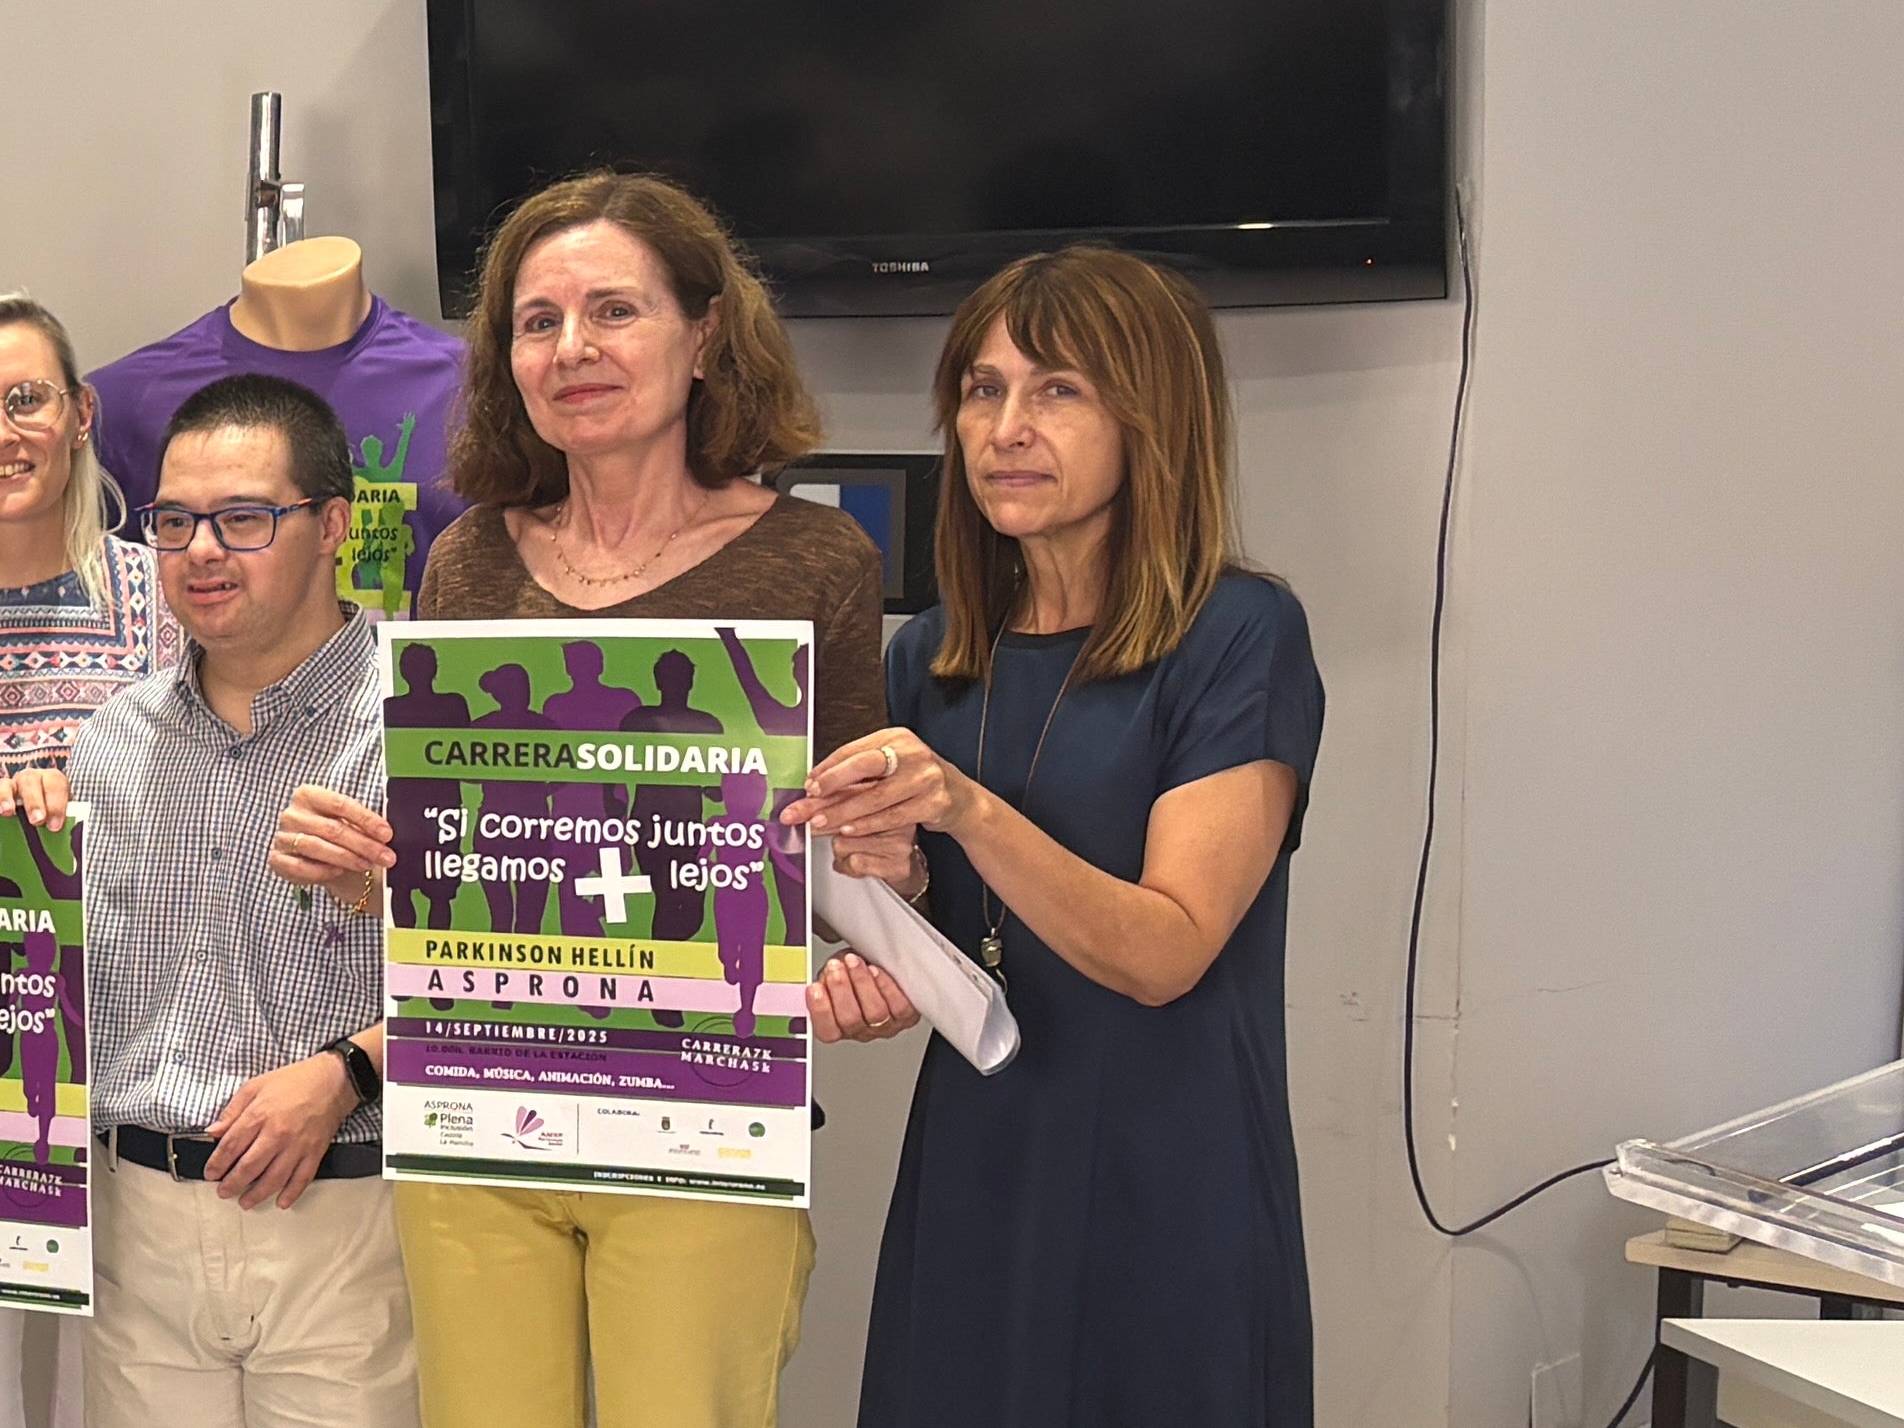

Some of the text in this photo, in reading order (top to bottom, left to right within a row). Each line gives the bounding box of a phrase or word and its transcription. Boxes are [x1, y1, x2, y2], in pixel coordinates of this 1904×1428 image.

[872, 261, 929, 273] TOSHIBA
[352, 489, 400, 503] ARIA
[344, 527, 398, 542] untos
[424, 740, 768, 775] CARRERASOLIDARIA
[480, 812, 641, 844] corremos
[647, 814, 765, 849] juntos
[424, 850, 566, 883] llegamos
[425, 939, 655, 970] PARKINSON HELLÍN
[428, 968, 655, 1003] ASPRONA
[425, 1021, 608, 1045] 14/SEPTIEMBRE/2025
[425, 1064, 480, 1080] COMIDA,
[483, 1066, 535, 1083] MÚSICA,
[538, 1070, 615, 1088] ANIMACIÓN,
[424, 1100, 473, 1111] ASPRONA
[440, 1113, 473, 1125] Plena
